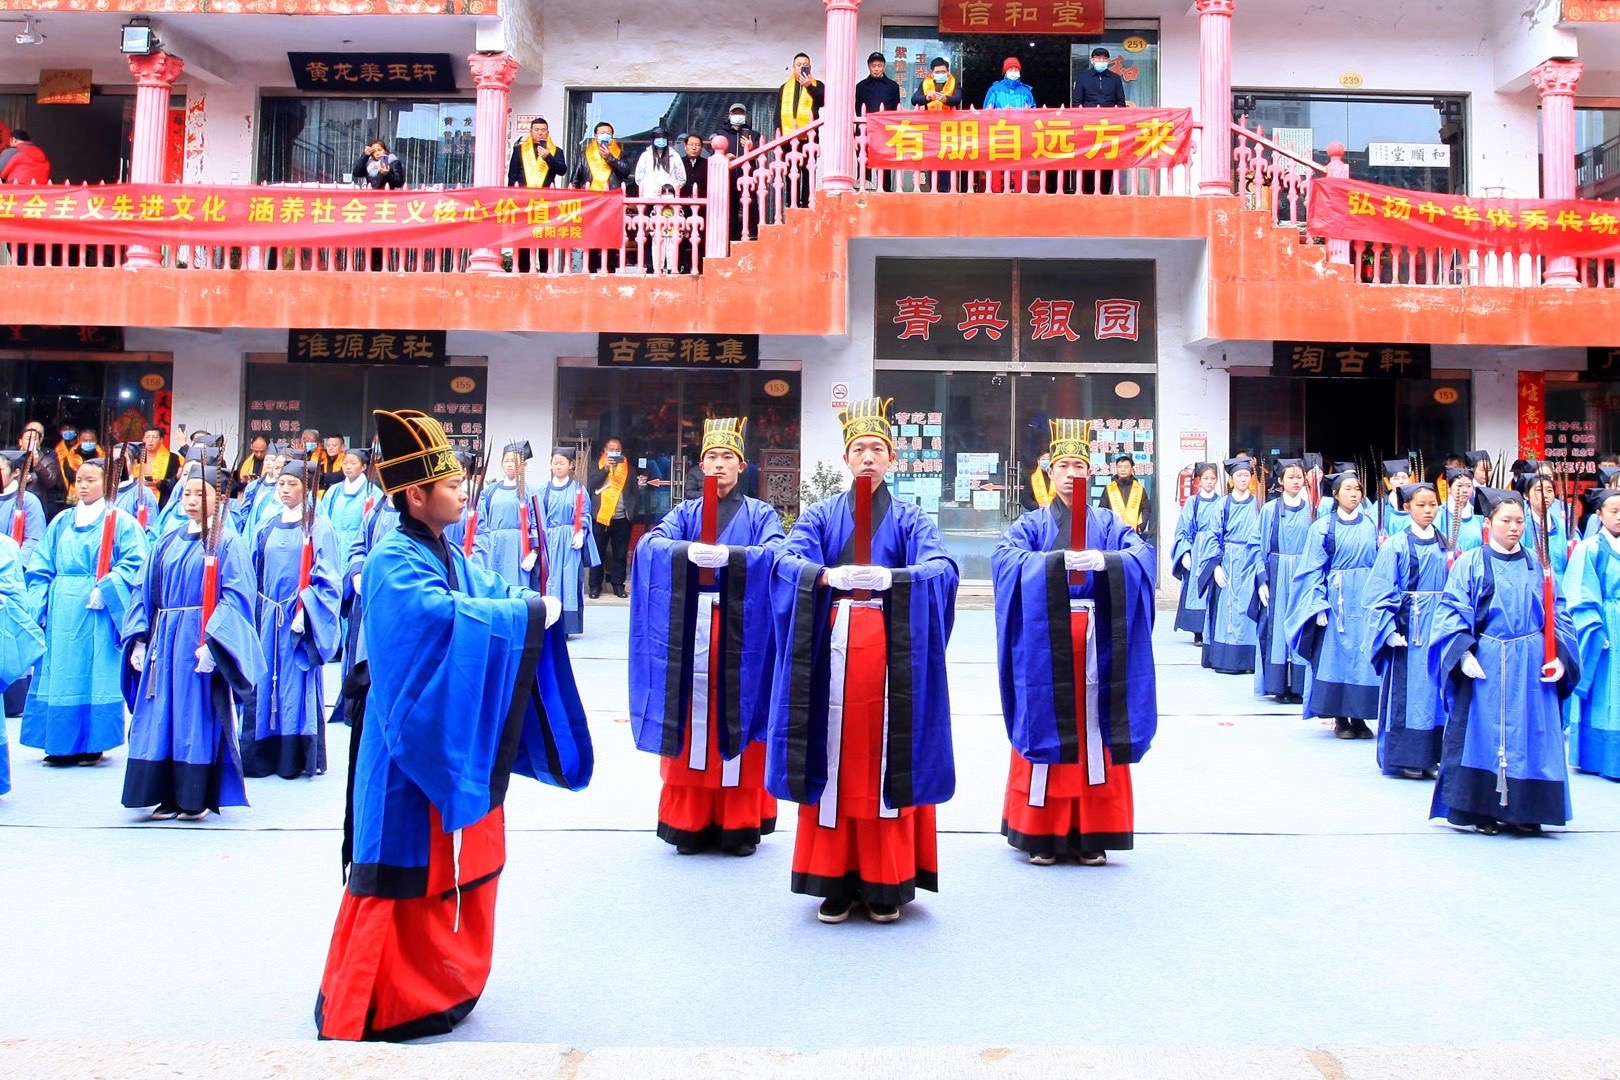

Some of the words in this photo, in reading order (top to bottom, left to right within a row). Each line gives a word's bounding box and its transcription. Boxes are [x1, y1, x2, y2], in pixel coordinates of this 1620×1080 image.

[959, 0, 1085, 28] 信和堂
[1127, 40, 1144, 49] 251
[305, 61, 438, 83] 黄龙美玉轩
[1343, 76, 1360, 85] 239
[884, 118, 1178, 162] 有朋自远方来
[0, 193, 227, 222] 社会主义先进文化
[248, 196, 583, 225] 涵养社会主义核心价值观
[1347, 191, 1620, 235] 弘扬中华优秀传统
[532, 226, 583, 239] 信阳学院
[893, 295, 1140, 342] 菁典银圆
[298, 333, 434, 361] 淮源泉社
[608, 337, 748, 364] 古雲雅集
[1292, 345, 1413, 374] 淘古軒
[455, 380, 471, 389] 155
[768, 383, 785, 392] 153
[1439, 391, 1454, 400] 151
[891, 412, 943, 425] 营范围
